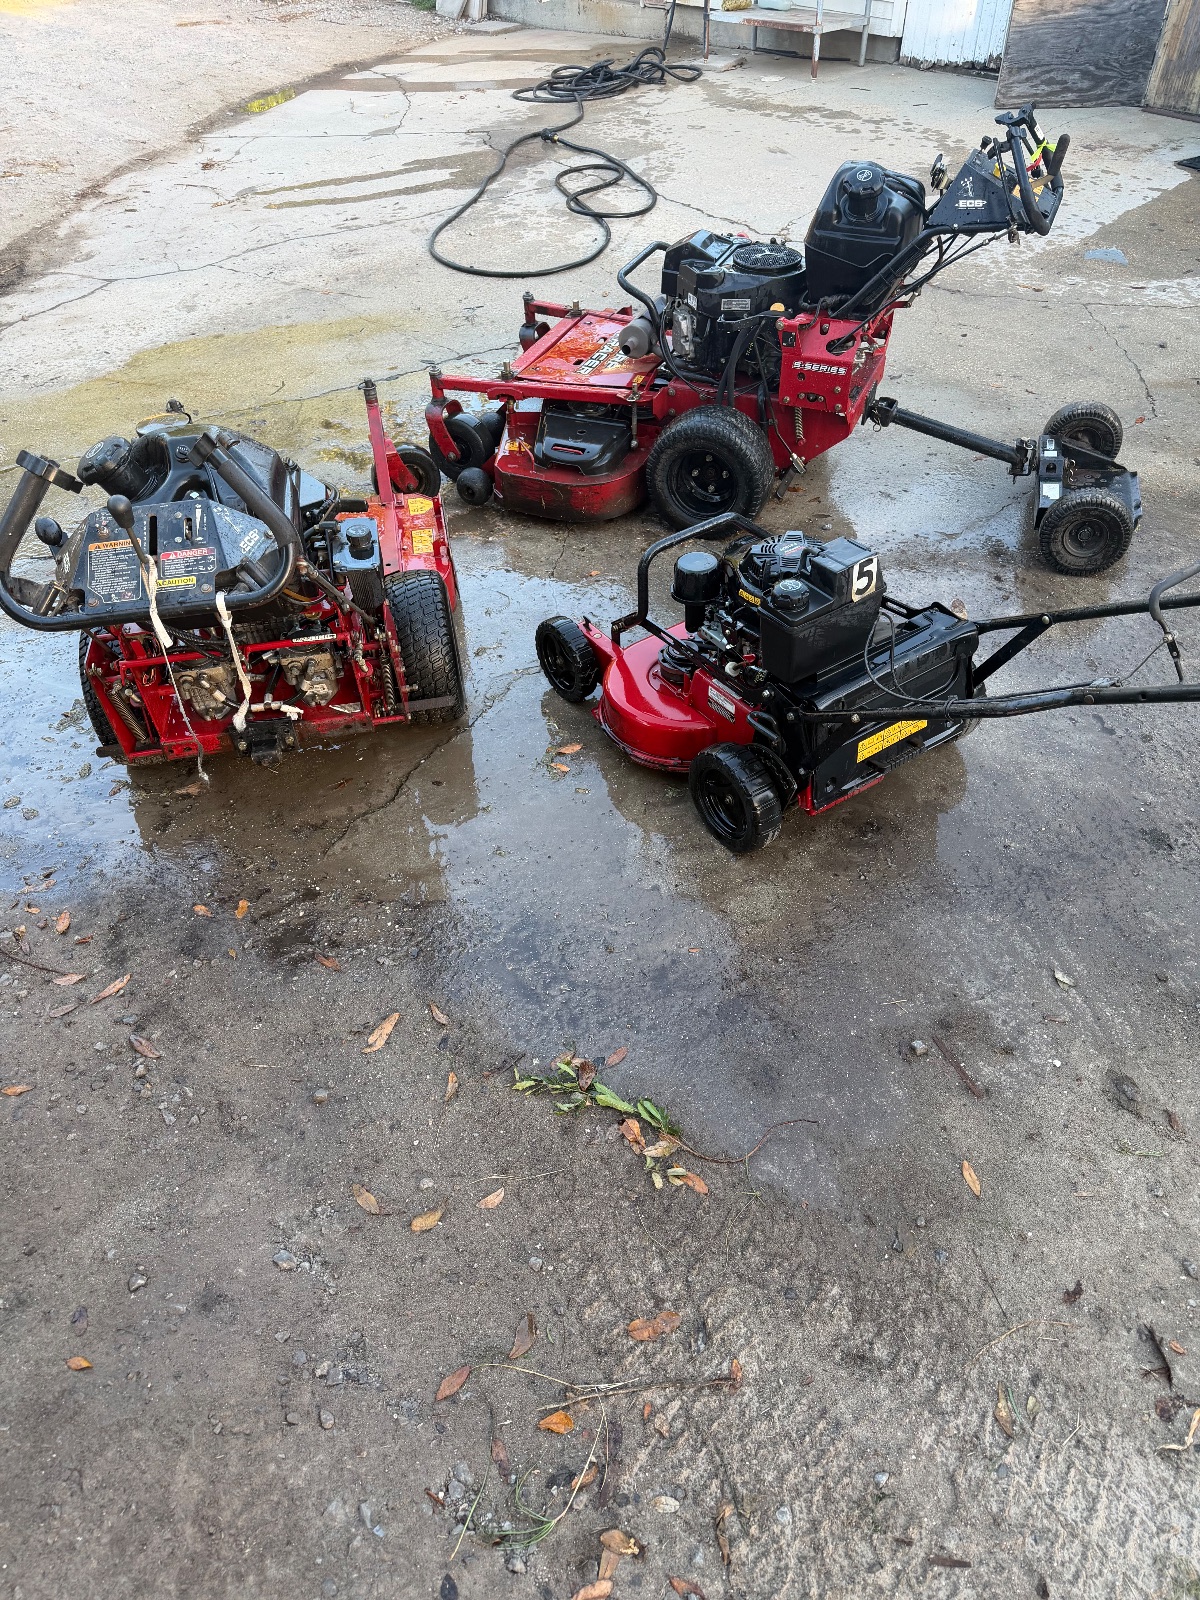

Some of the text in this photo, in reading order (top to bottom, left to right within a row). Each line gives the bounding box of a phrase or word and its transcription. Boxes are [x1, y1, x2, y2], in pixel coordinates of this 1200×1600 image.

[793, 361, 848, 375] S-SERIES
[102, 540, 132, 549] WARNIN
[162, 577, 194, 586] CAUTION
[854, 558, 874, 596] 5
